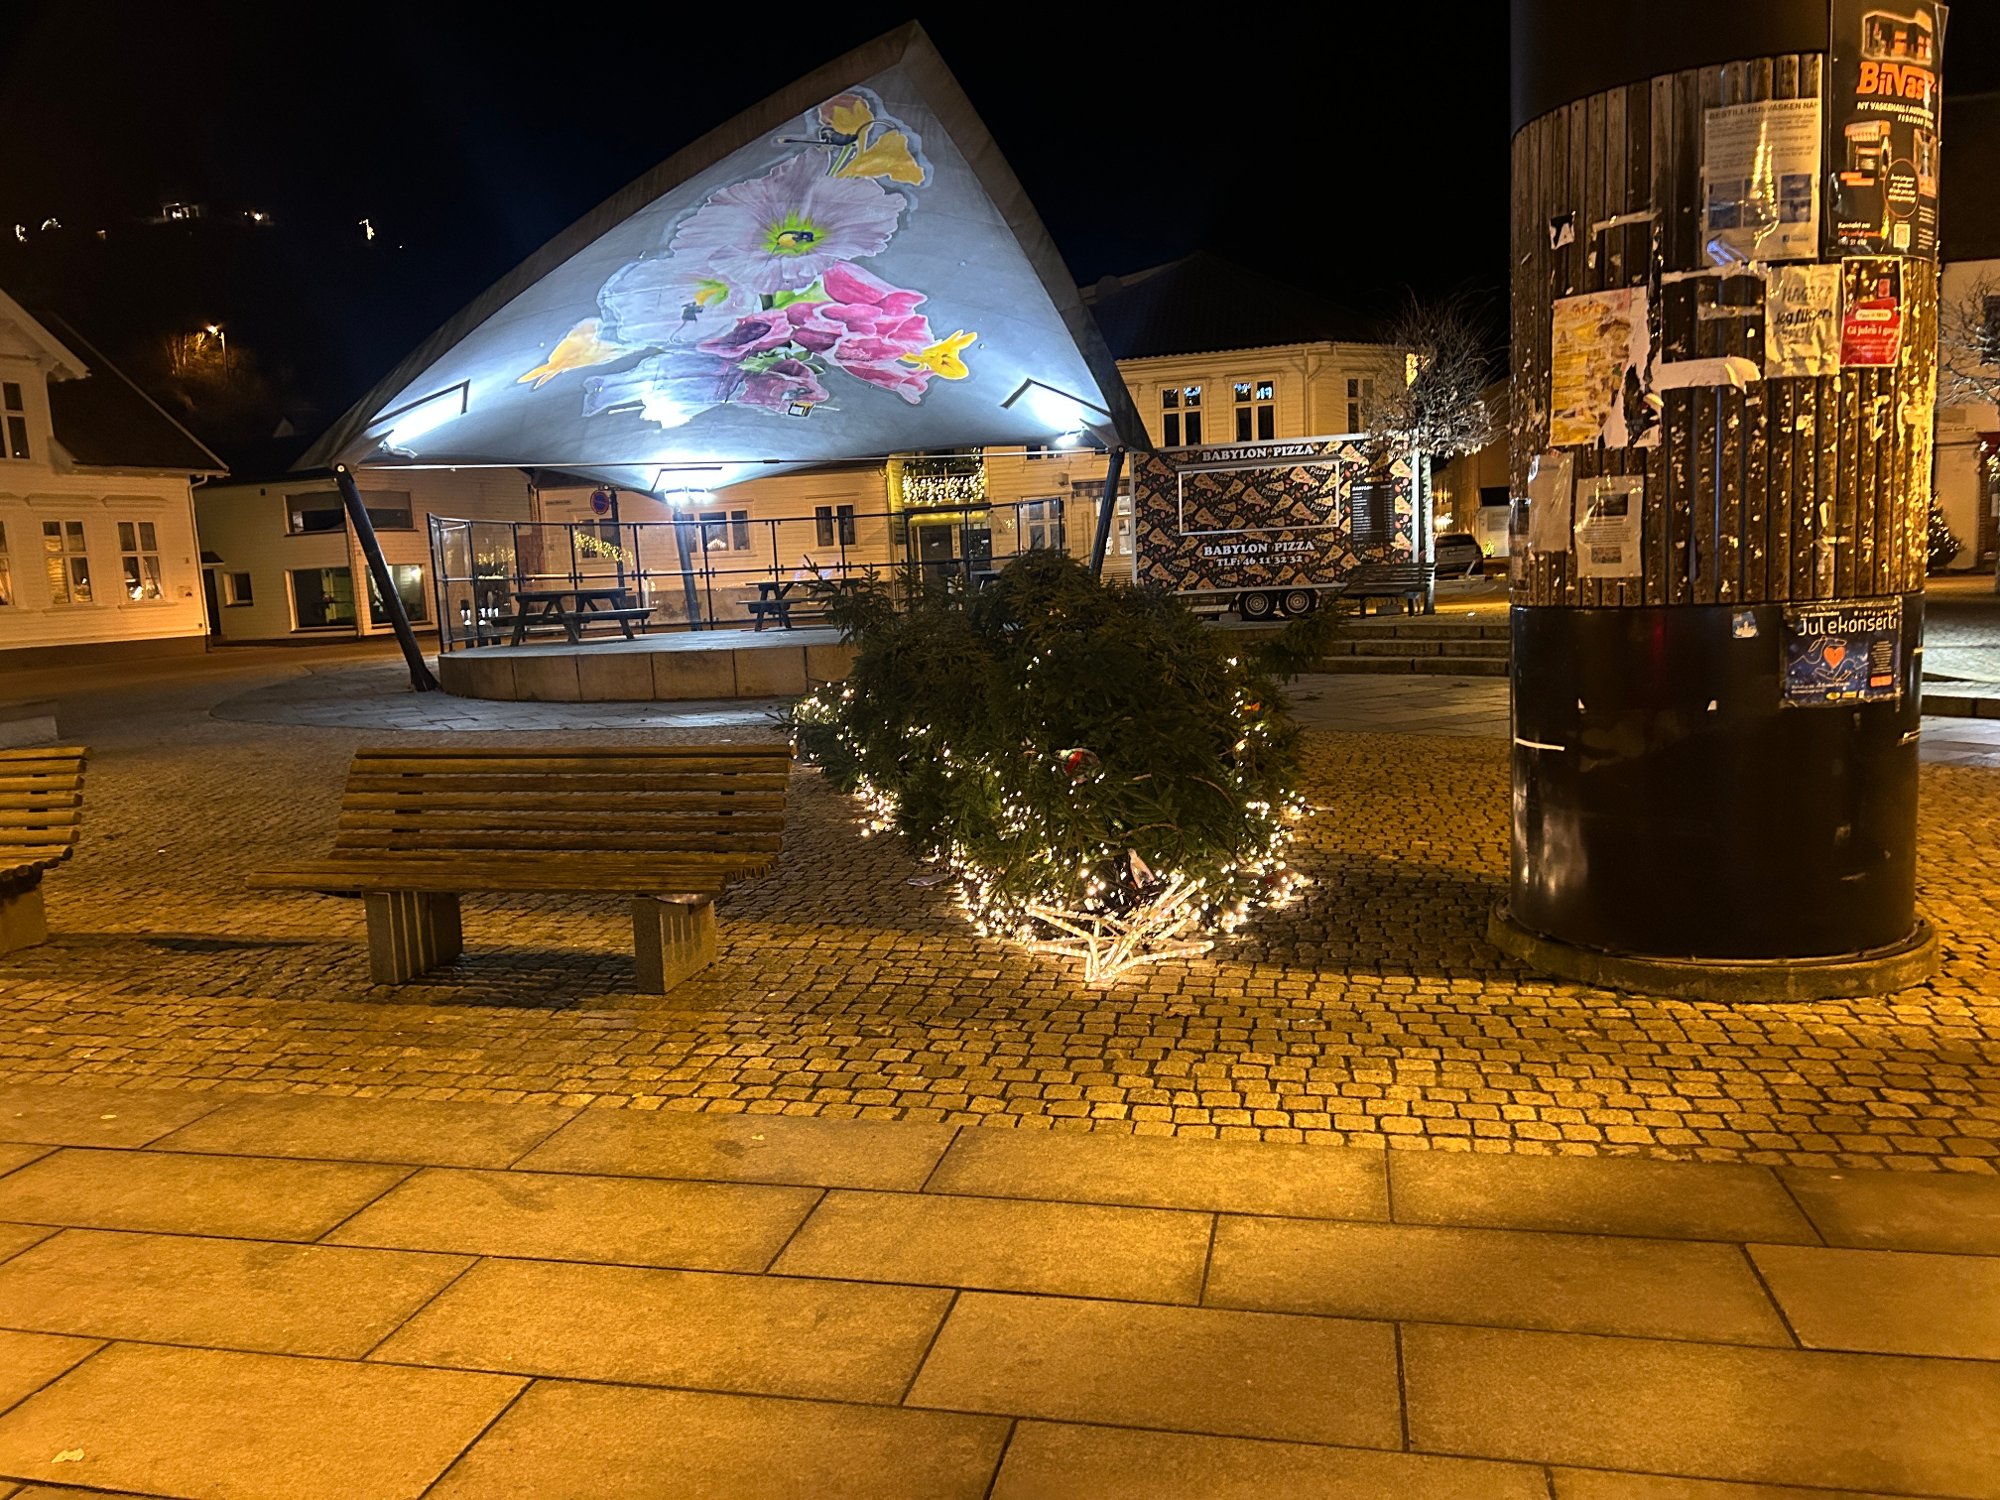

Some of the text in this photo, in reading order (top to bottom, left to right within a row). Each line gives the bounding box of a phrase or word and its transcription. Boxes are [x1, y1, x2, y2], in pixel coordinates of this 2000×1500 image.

[1202, 444, 1315, 462] BABYLON PIZZA
[1261, 488, 1280, 496] Pizza
[1204, 540, 1315, 556] BABYLON PIZZA
[1216, 555, 1303, 567] TLF: 46 11 32 32
